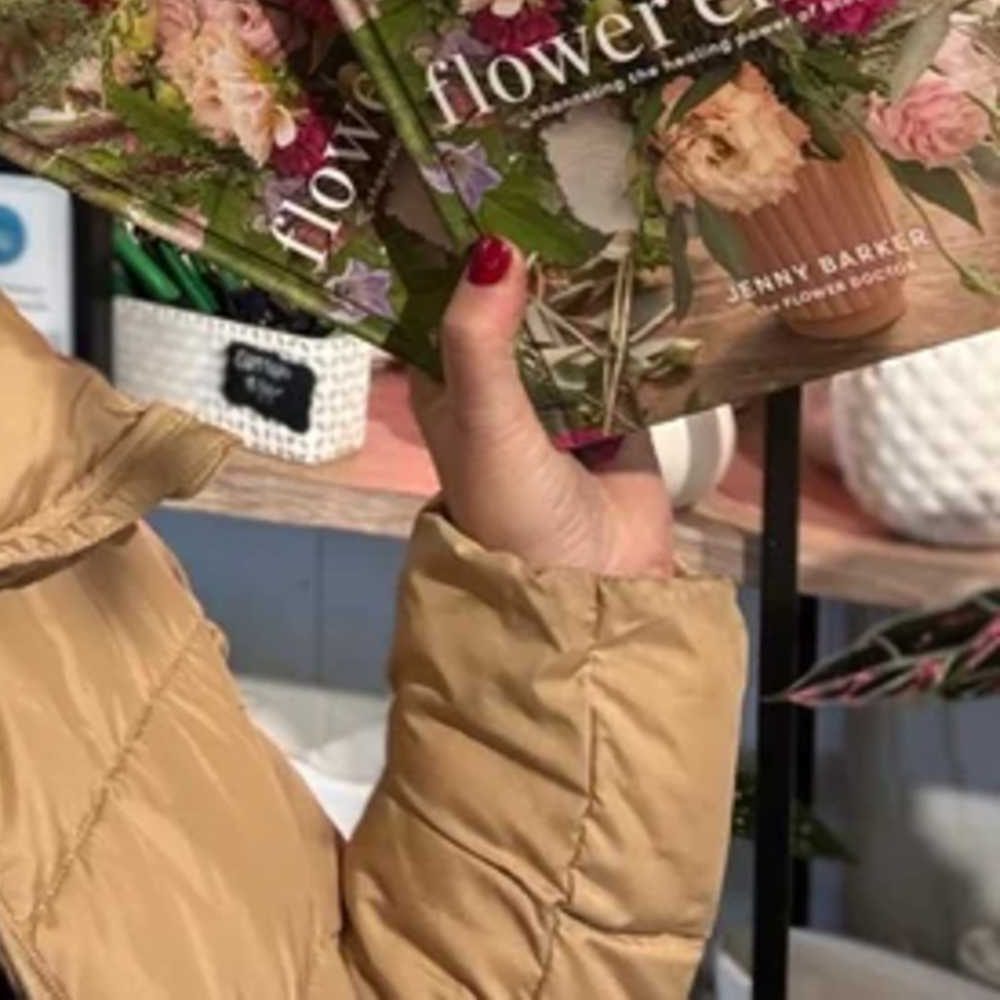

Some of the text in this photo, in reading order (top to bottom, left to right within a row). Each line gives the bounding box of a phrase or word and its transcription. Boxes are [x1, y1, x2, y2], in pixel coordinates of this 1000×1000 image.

[628, 66, 659, 84] the
[662, 38, 732, 71] healing
[735, 17, 792, 48] power
[797, 3, 818, 23] of
[726, 228, 931, 304] JENNY BARKER
[782, 279, 848, 309] FLOWER
